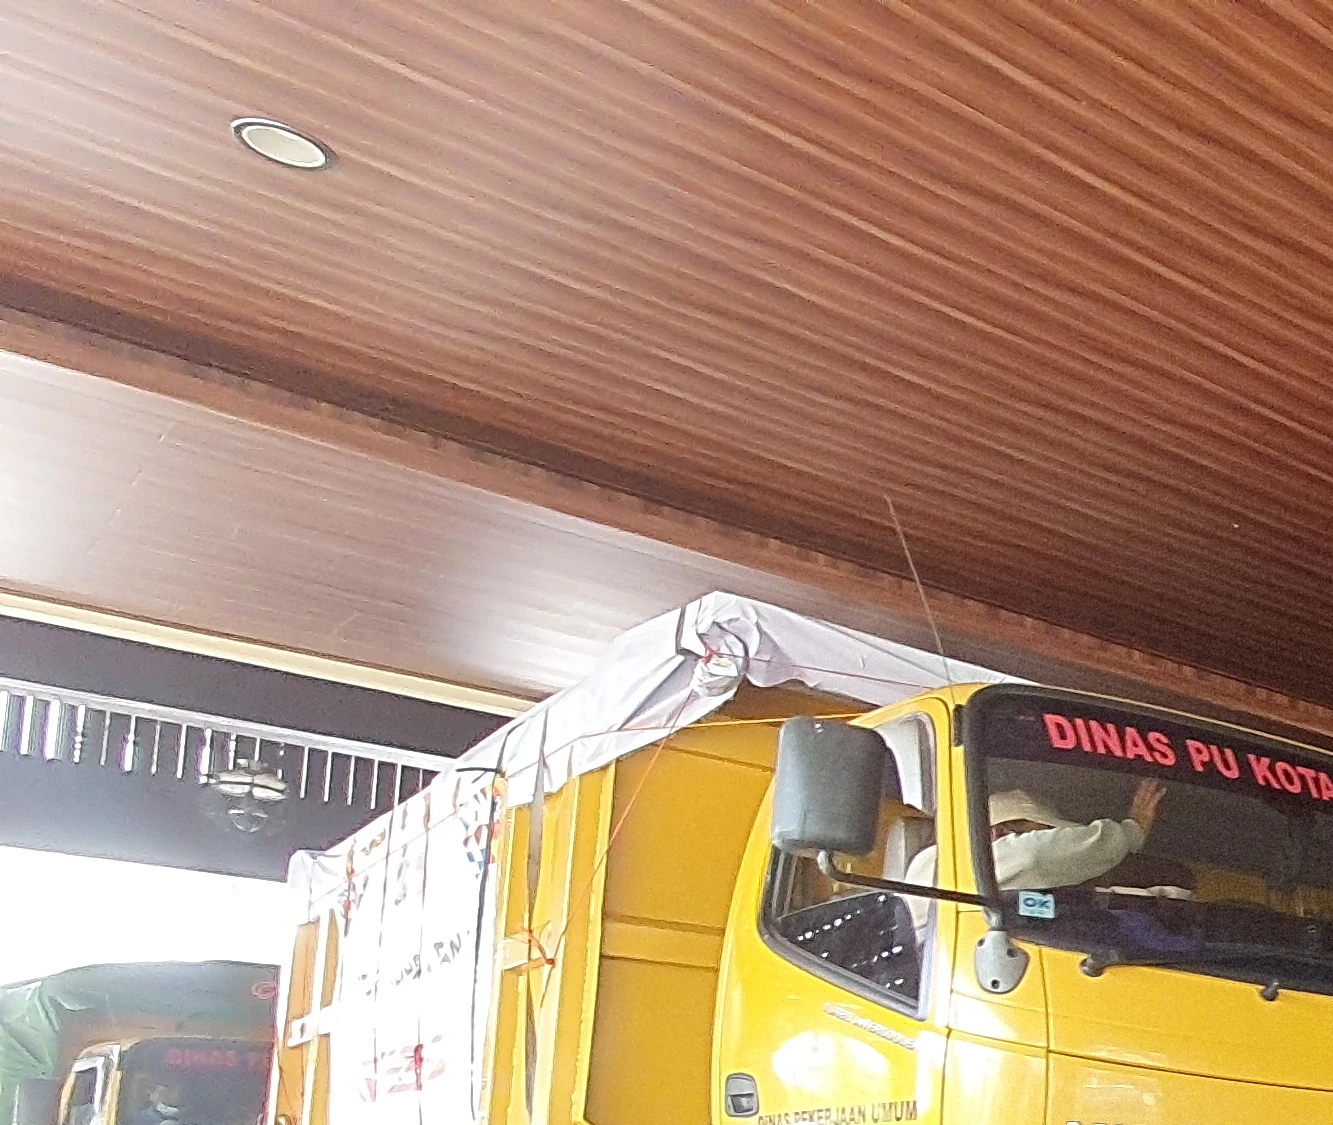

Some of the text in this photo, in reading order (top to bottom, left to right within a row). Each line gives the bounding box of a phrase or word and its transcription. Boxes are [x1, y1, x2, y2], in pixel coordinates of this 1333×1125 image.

[1043, 713, 1176, 766] DINAS
[1185, 739, 1240, 779] PU
[871, 1100, 918, 1124] UMUM
